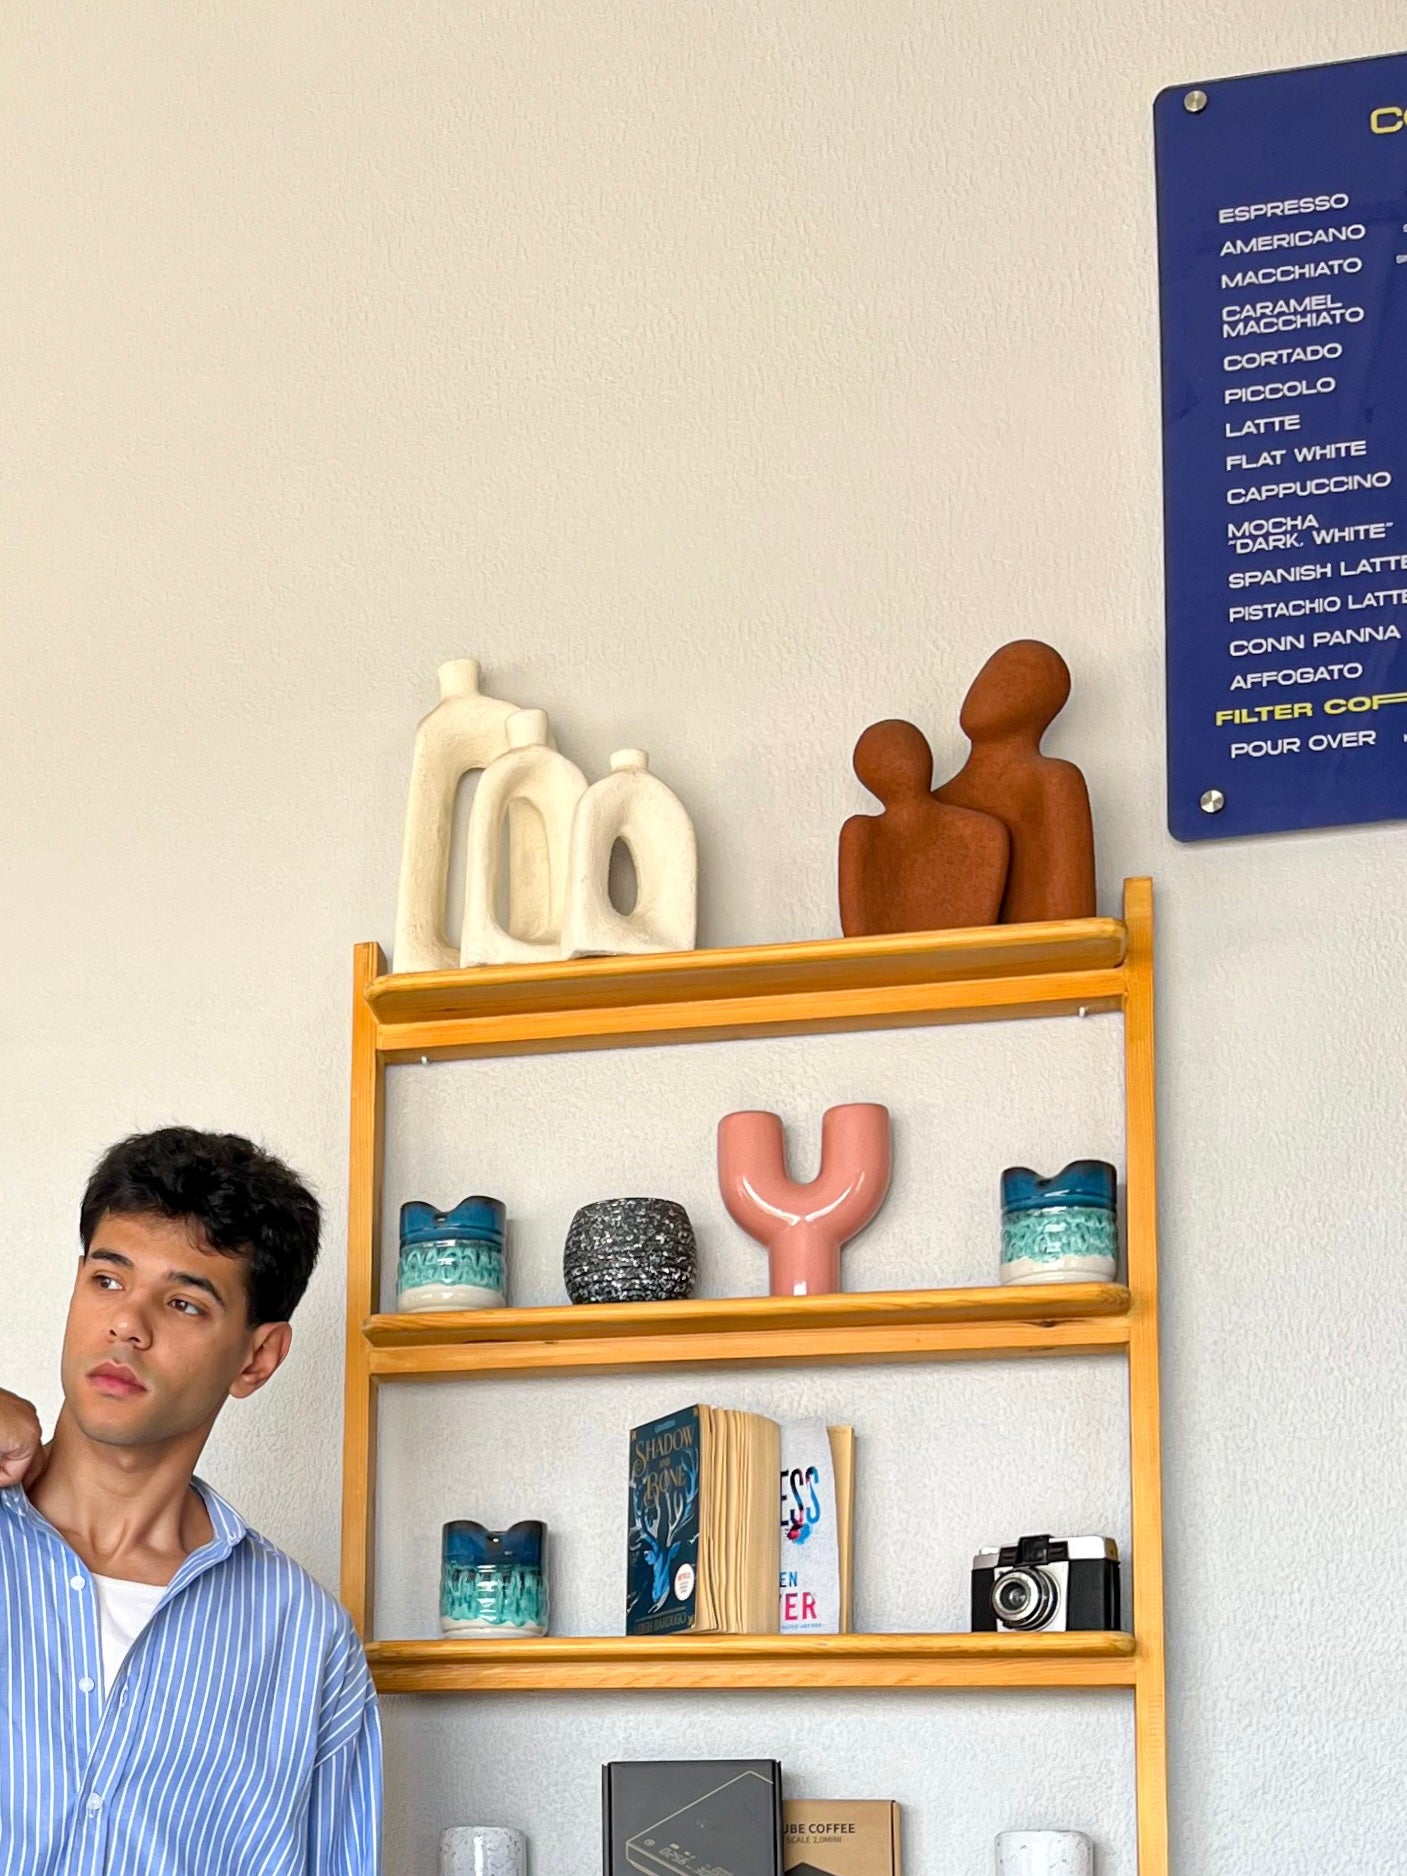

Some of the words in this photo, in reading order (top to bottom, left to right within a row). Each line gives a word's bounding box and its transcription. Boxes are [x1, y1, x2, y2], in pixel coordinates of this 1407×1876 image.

[1370, 106, 1407, 134] C
[1219, 194, 1349, 223] ESPRESSO
[1220, 224, 1366, 256] AMERICANO
[1221, 257, 1363, 289] MACCHIATO
[1222, 295, 1342, 322] CARAMEL
[1223, 307, 1365, 338] MACCHIATO
[1224, 343, 1343, 371] CORTADO
[1225, 377, 1336, 404] PICCOLO
[1225, 414, 1301, 437] LATTE
[1226, 450, 1287, 471] FLAT
[1294, 440, 1367, 463] WHITE
[1226, 471, 1392, 504] CAPPUCCINO
[1227, 514, 1319, 538] MOCHA
[1228, 563, 1332, 589] SPANISH
[1229, 596, 1341, 623] PISTACHIO
[1229, 634, 1305, 657] CONN
[1313, 624, 1401, 648] PANNA
[1230, 662, 1363, 691] AFFOGATO
[1215, 702, 1313, 726] FILTER
[1230, 736, 1300, 759] POUR
[1308, 730, 1376, 751] OVER
[633, 1424, 694, 1477] SHADOW
[644, 1465, 687, 1507] BONE
[808, 1823, 856, 1834] COFFEE
